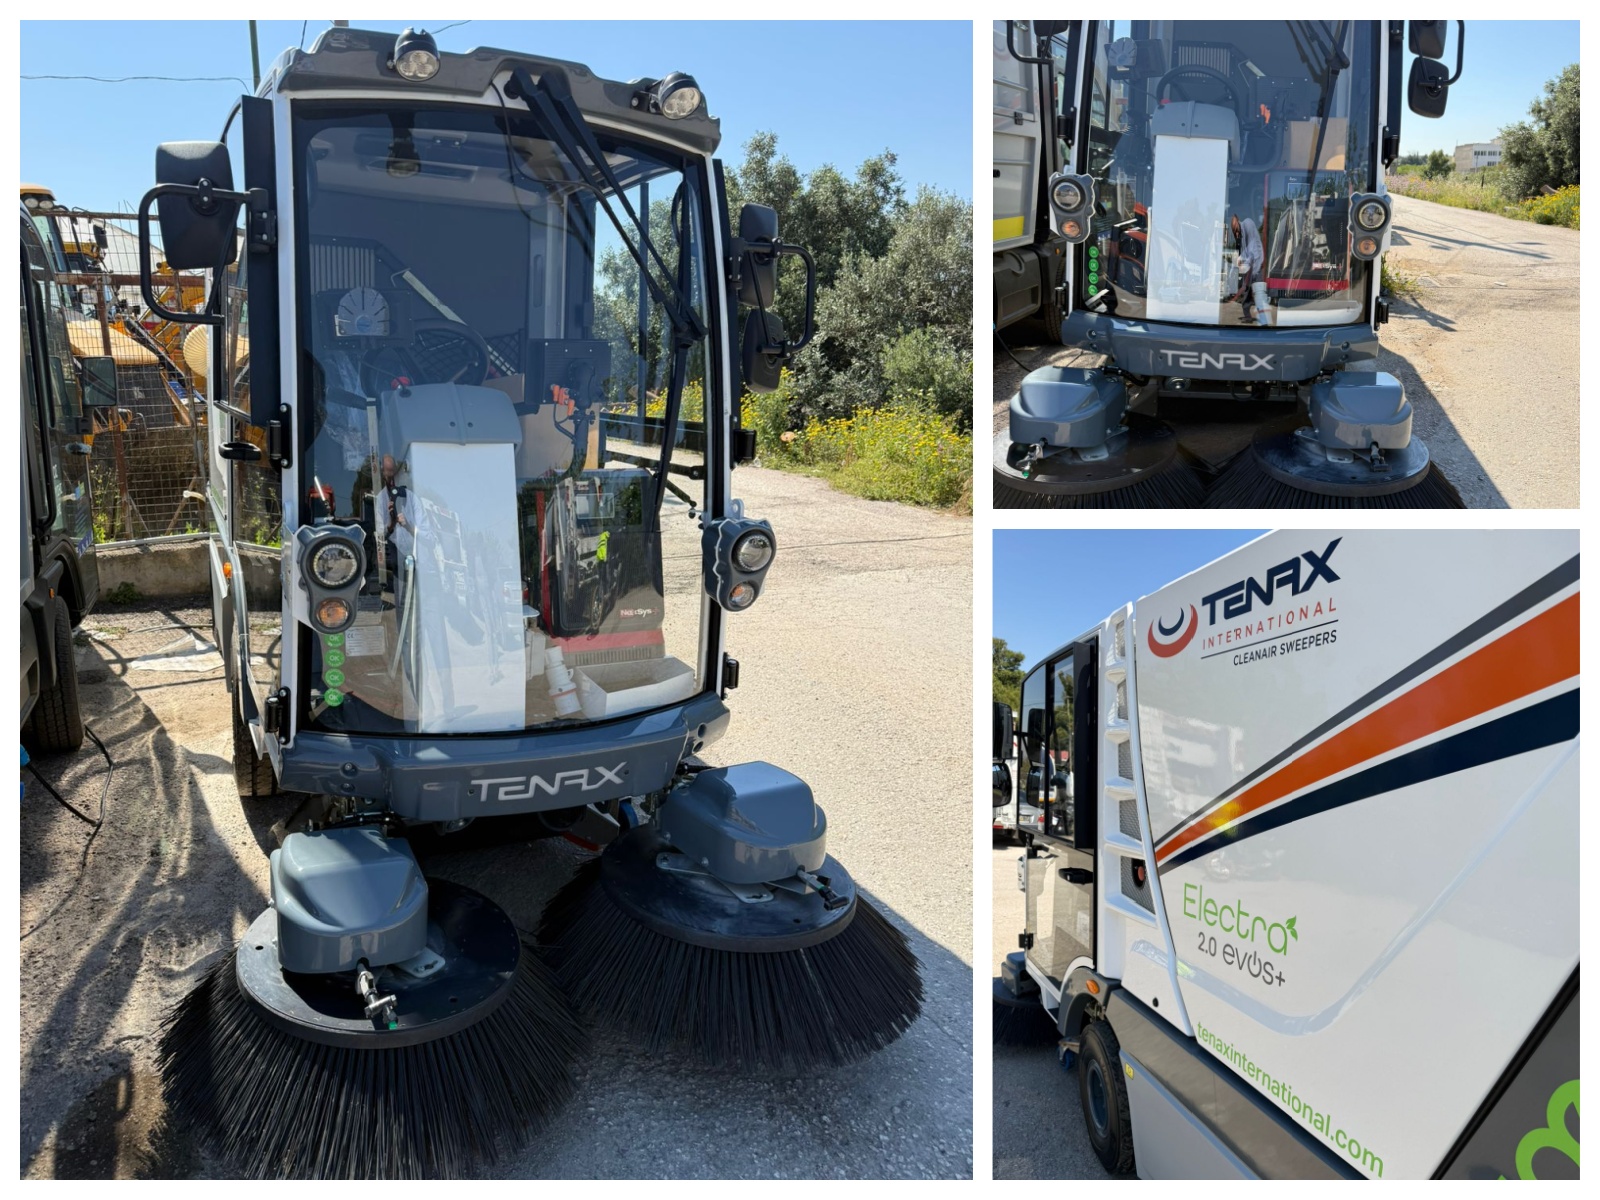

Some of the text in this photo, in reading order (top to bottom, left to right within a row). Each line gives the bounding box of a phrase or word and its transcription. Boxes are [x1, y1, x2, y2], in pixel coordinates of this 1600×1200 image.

[1160, 349, 1275, 371] TENAX
[1201, 536, 1343, 626] TENAX
[1202, 598, 1337, 650] INTERNATIONAL
[1233, 629, 1337, 666] CLEANAIR SWEEPERS
[470, 761, 627, 802] TENAX
[1183, 882, 1288, 956] Electra
[1198, 931, 1217, 957] 2.0
[1197, 1021, 1384, 1178] tenaxinternational.com
